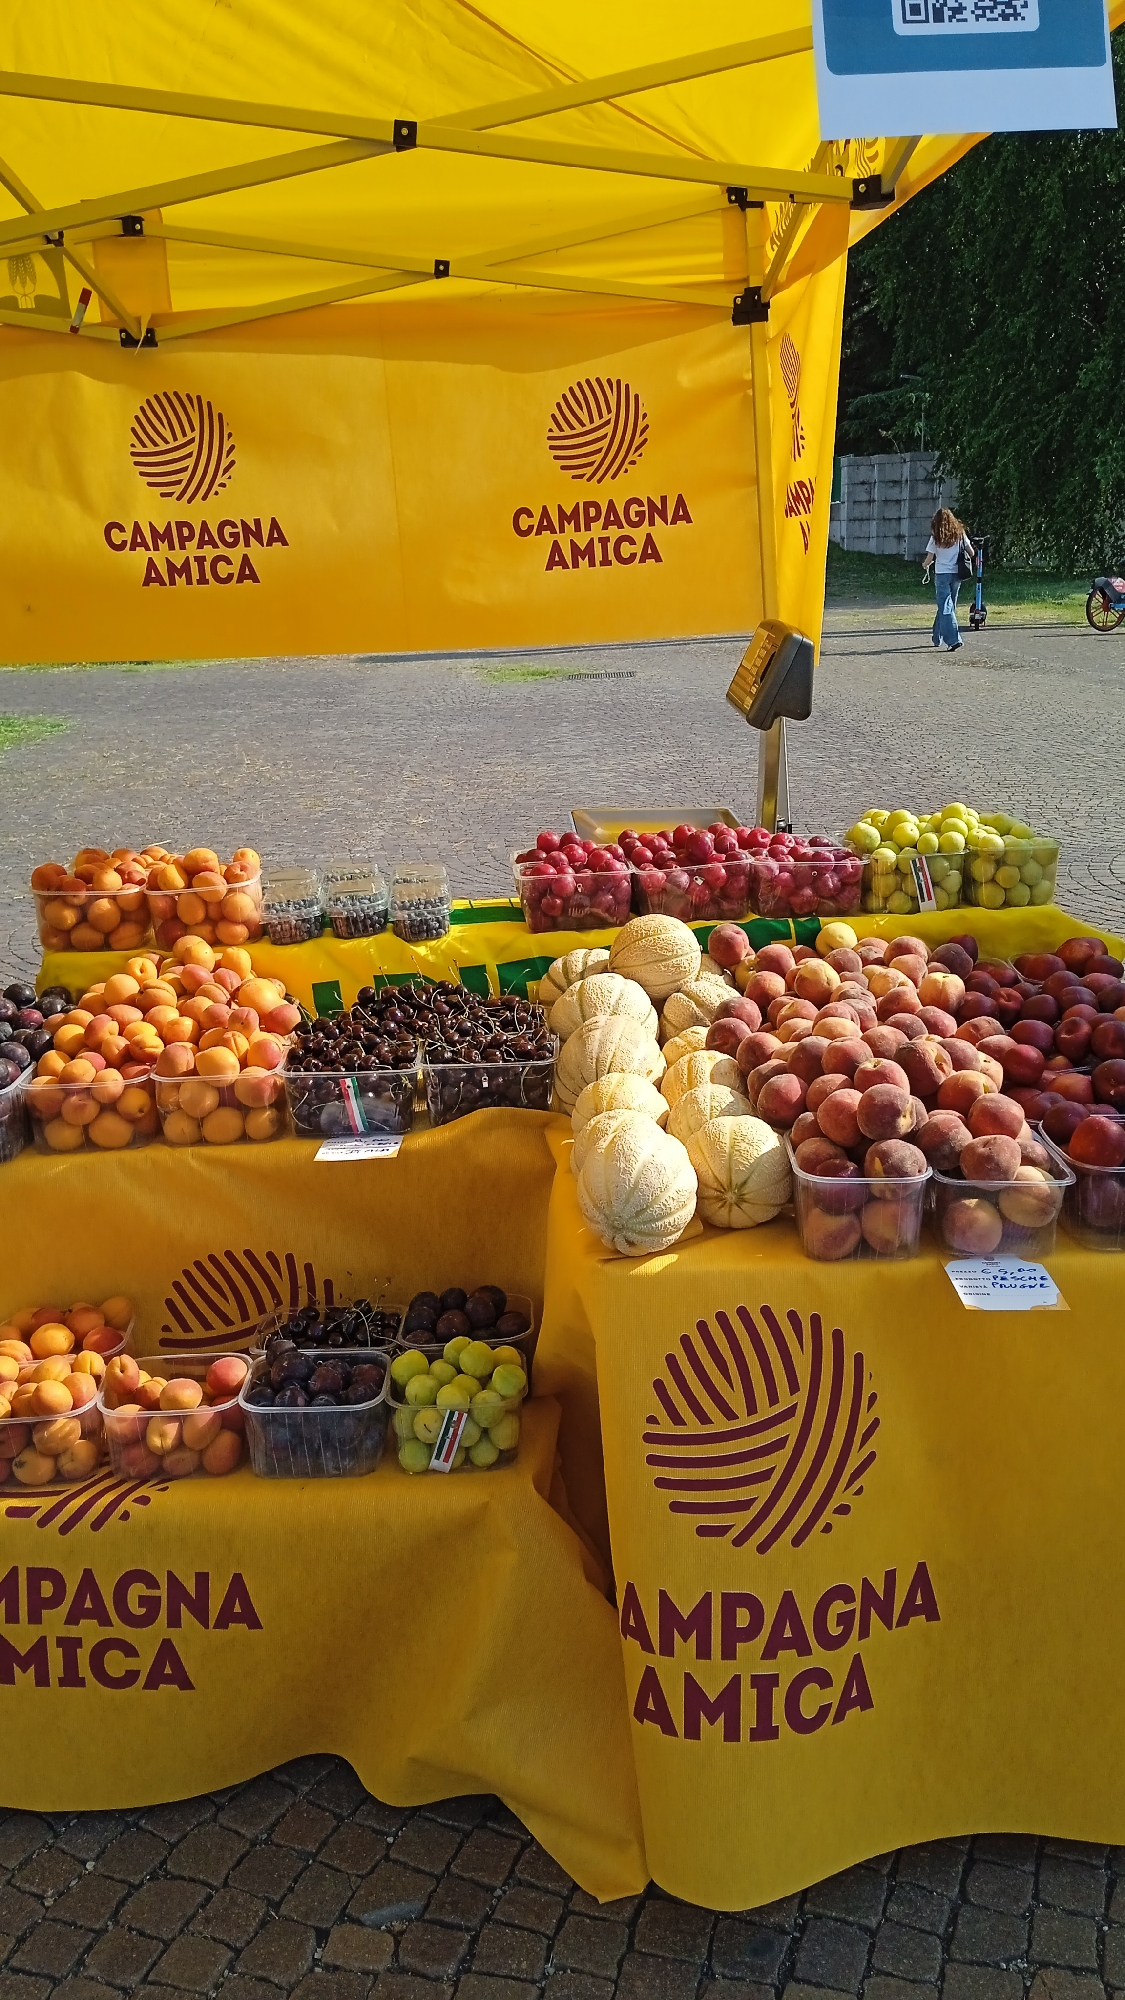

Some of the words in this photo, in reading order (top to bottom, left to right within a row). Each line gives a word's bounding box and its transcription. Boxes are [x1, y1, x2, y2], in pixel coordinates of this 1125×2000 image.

[104, 516, 289, 551] CAMPAGNA
[513, 493, 693, 537] CAMPAGNA
[142, 553, 260, 587] AMICA
[545, 532, 663, 571] AMICA
[992, 1274, 1048, 1282] PESCHE
[633, 1652, 874, 1743] AMICA
